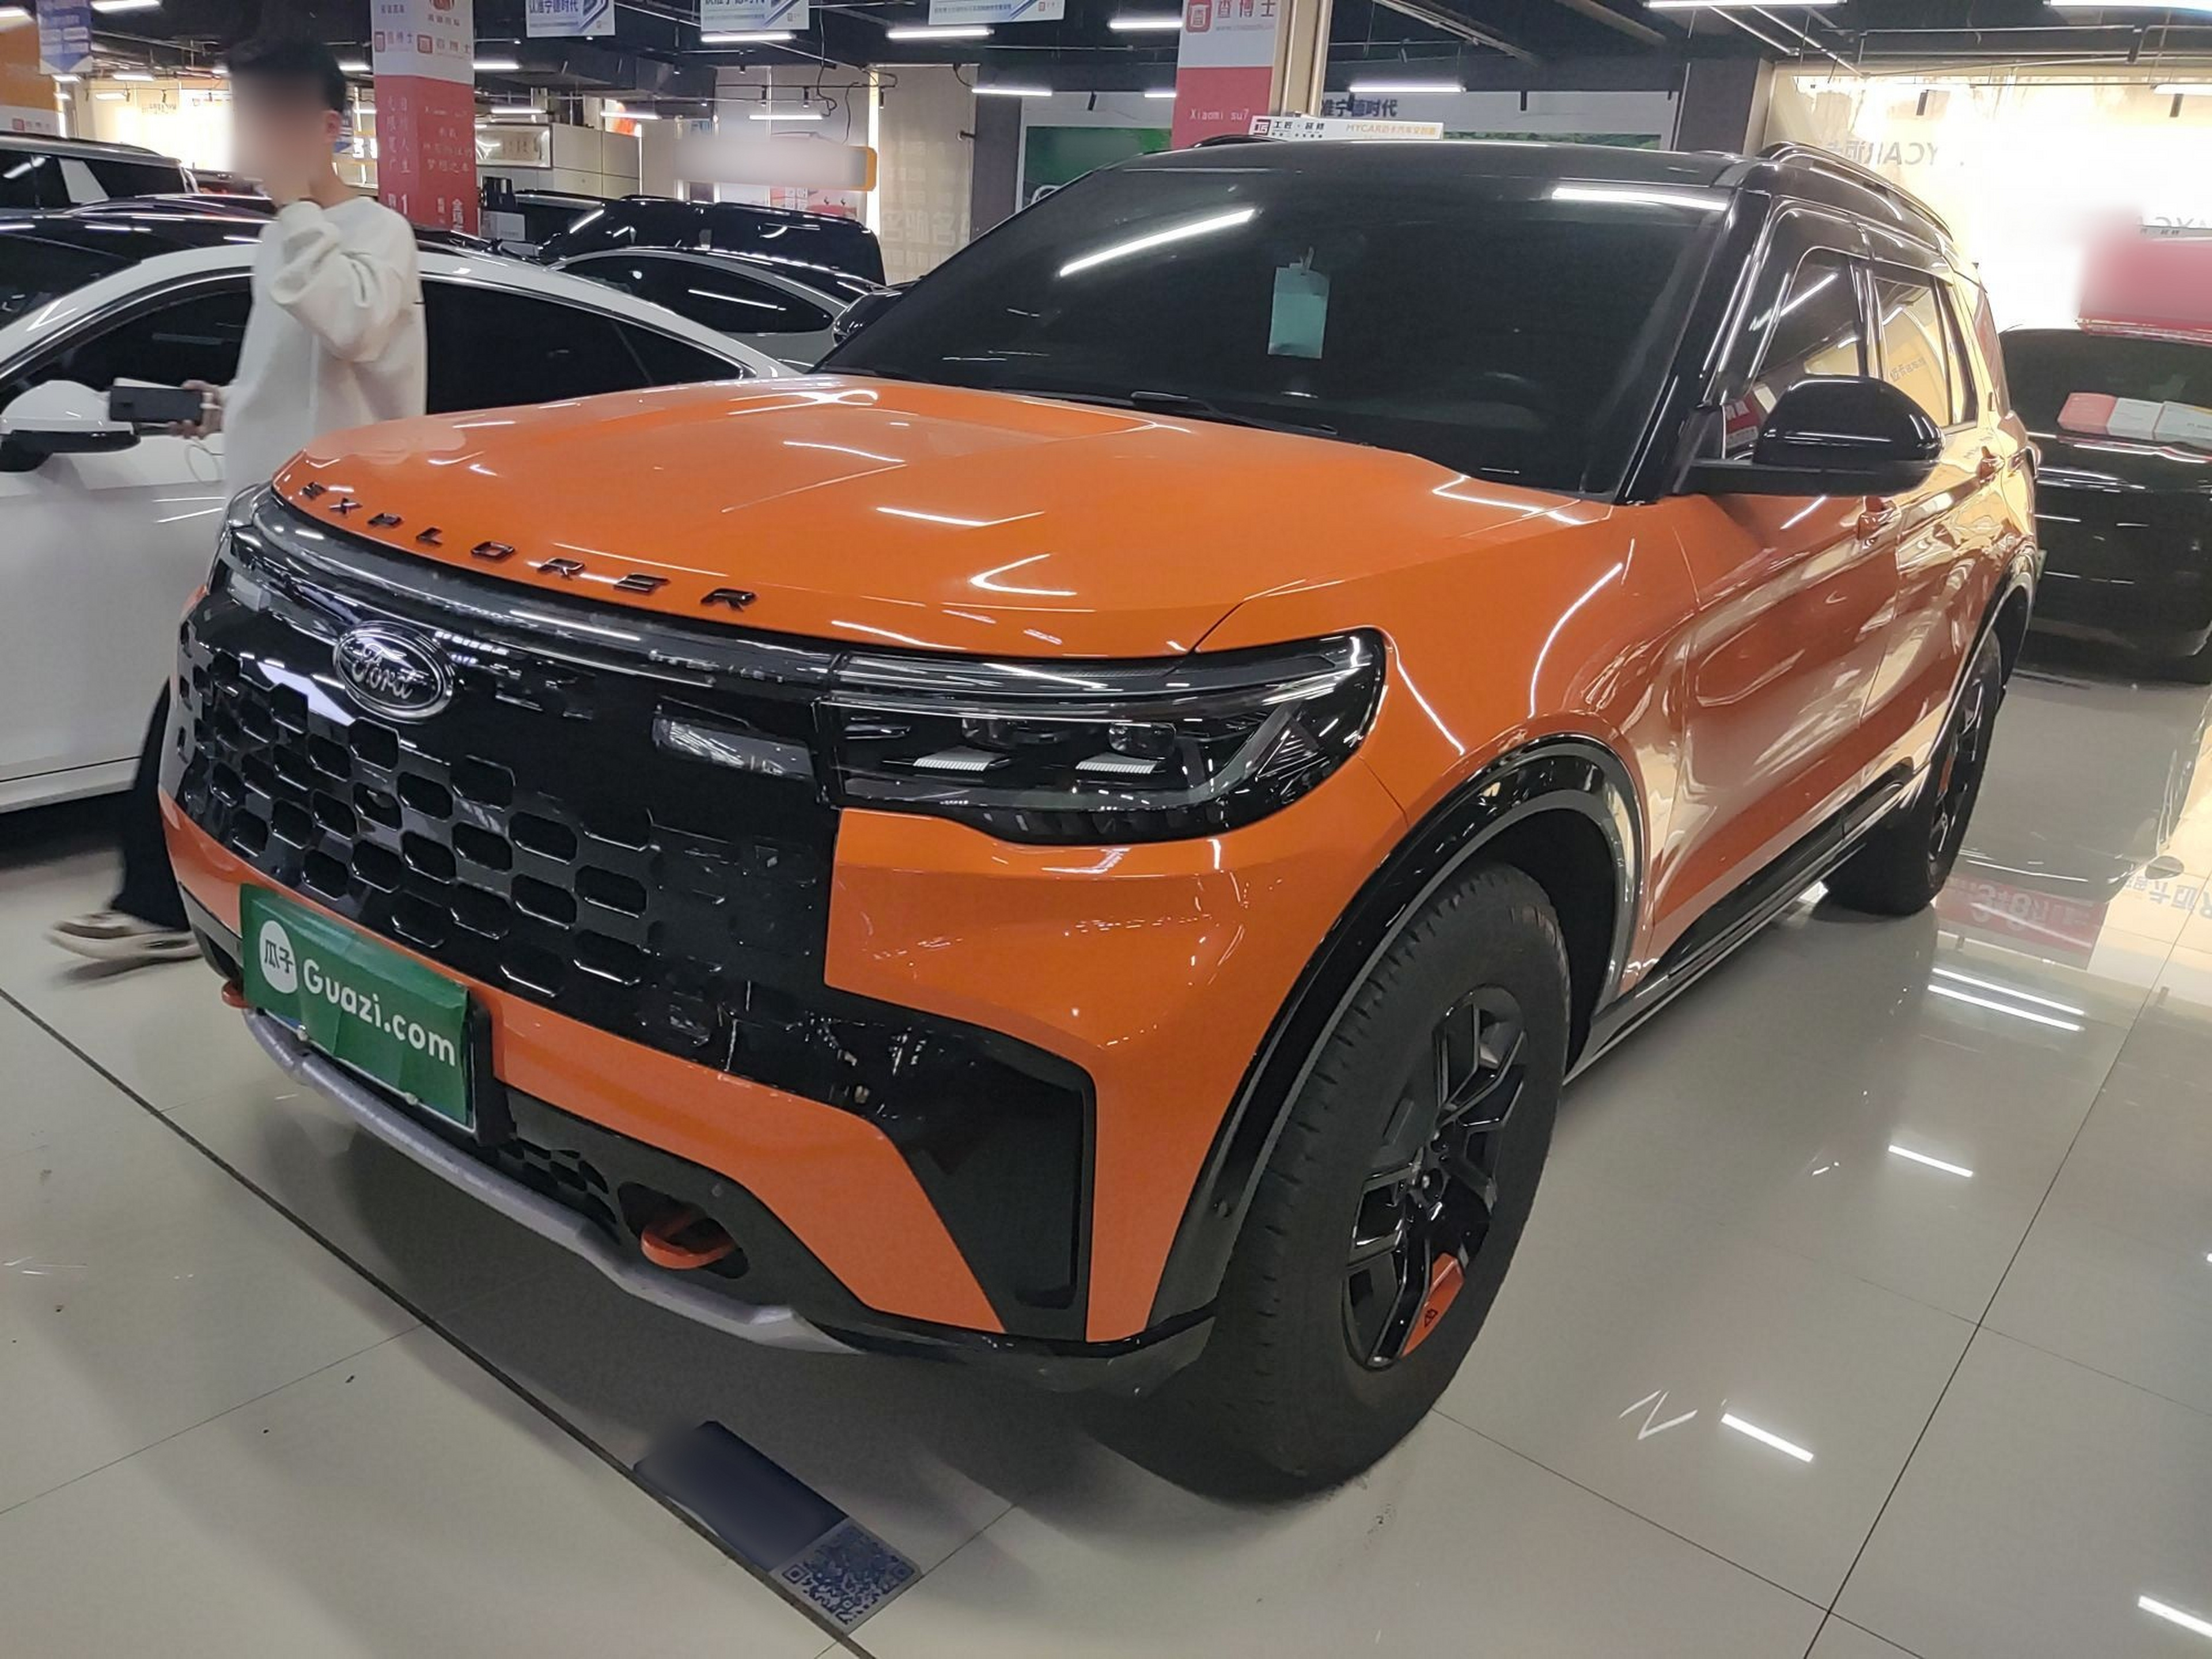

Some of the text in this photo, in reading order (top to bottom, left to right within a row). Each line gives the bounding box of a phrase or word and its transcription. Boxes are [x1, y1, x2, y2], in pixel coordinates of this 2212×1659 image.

[1190, 109, 1249, 120] Xiaomi su7
[302, 481, 756, 611] EXPLORER
[352, 643, 415, 699] Ford
[264, 938, 455, 1066] 瓜子 Guazi.com
